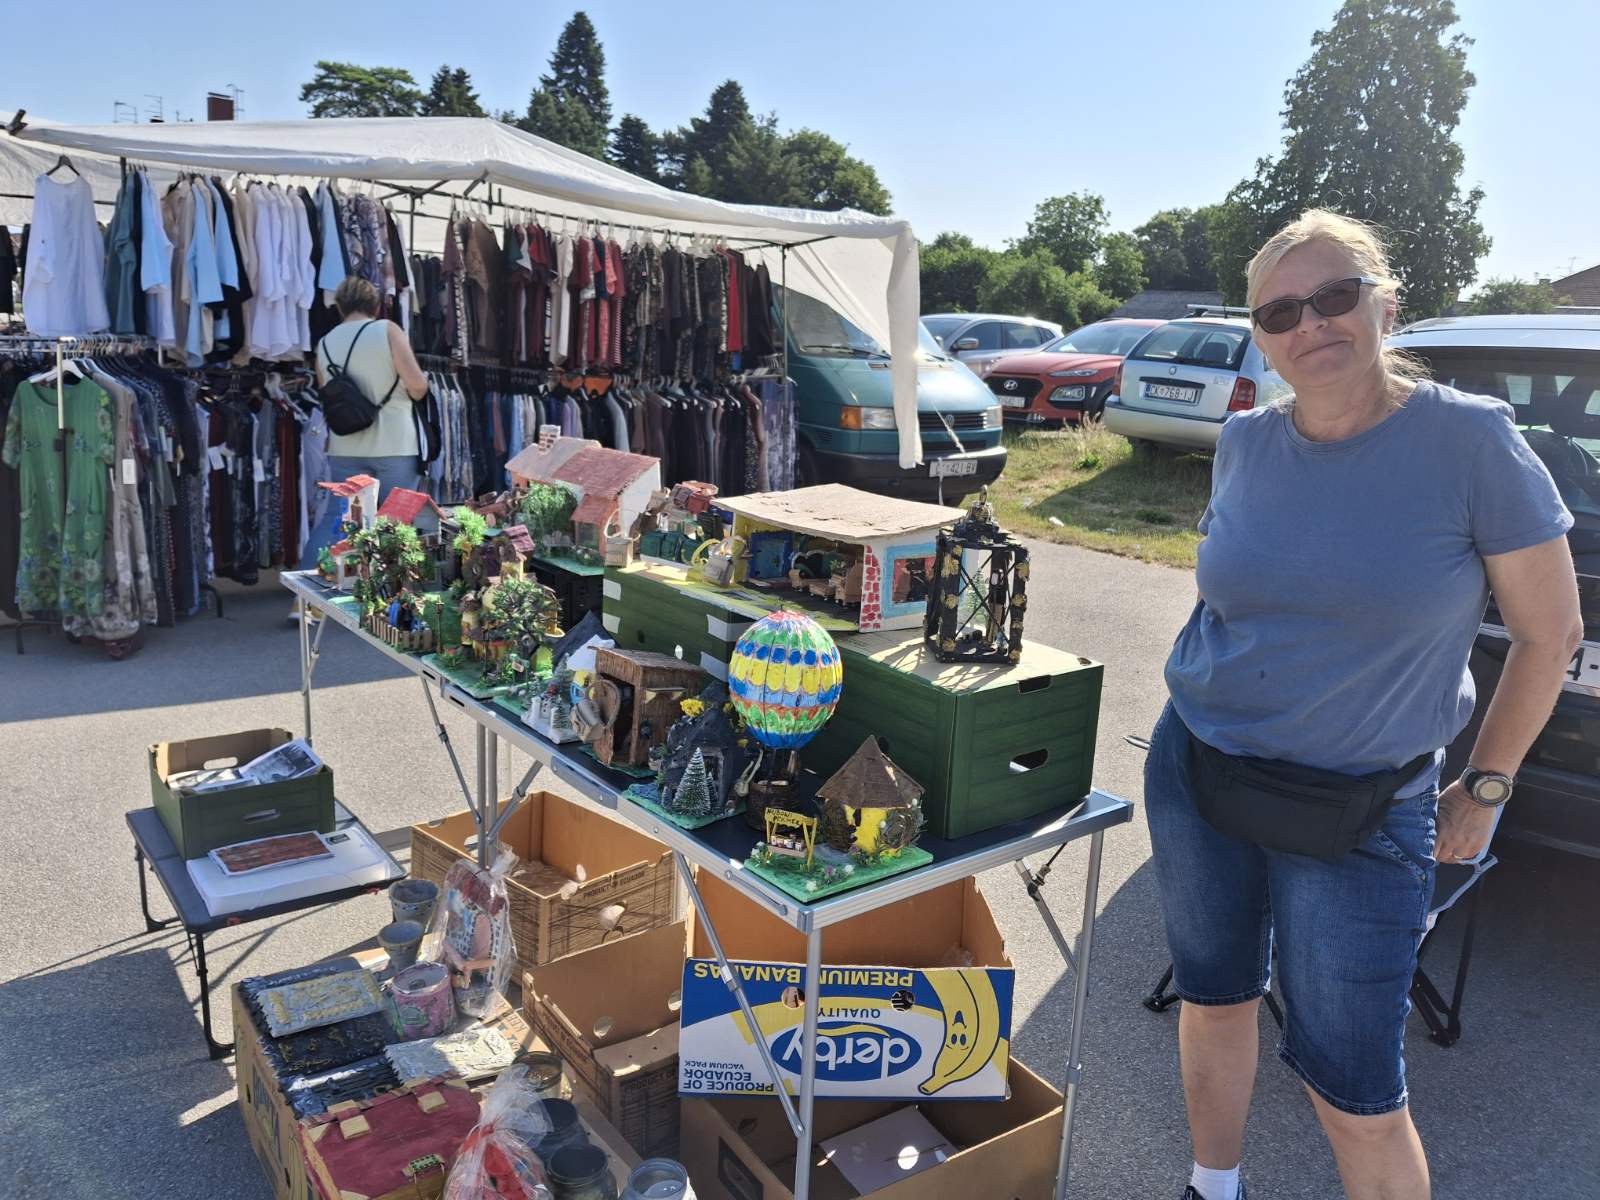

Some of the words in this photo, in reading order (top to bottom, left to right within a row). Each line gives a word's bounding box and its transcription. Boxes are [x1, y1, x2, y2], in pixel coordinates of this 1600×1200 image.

[818, 1007, 880, 1018] QUALITY
[782, 1025, 911, 1080] derby
[710, 1062, 744, 1070] VACUUM
[684, 1069, 752, 1082] ECUADOR
[683, 1079, 703, 1089] OF
[706, 1081, 774, 1092] PRODUCE
